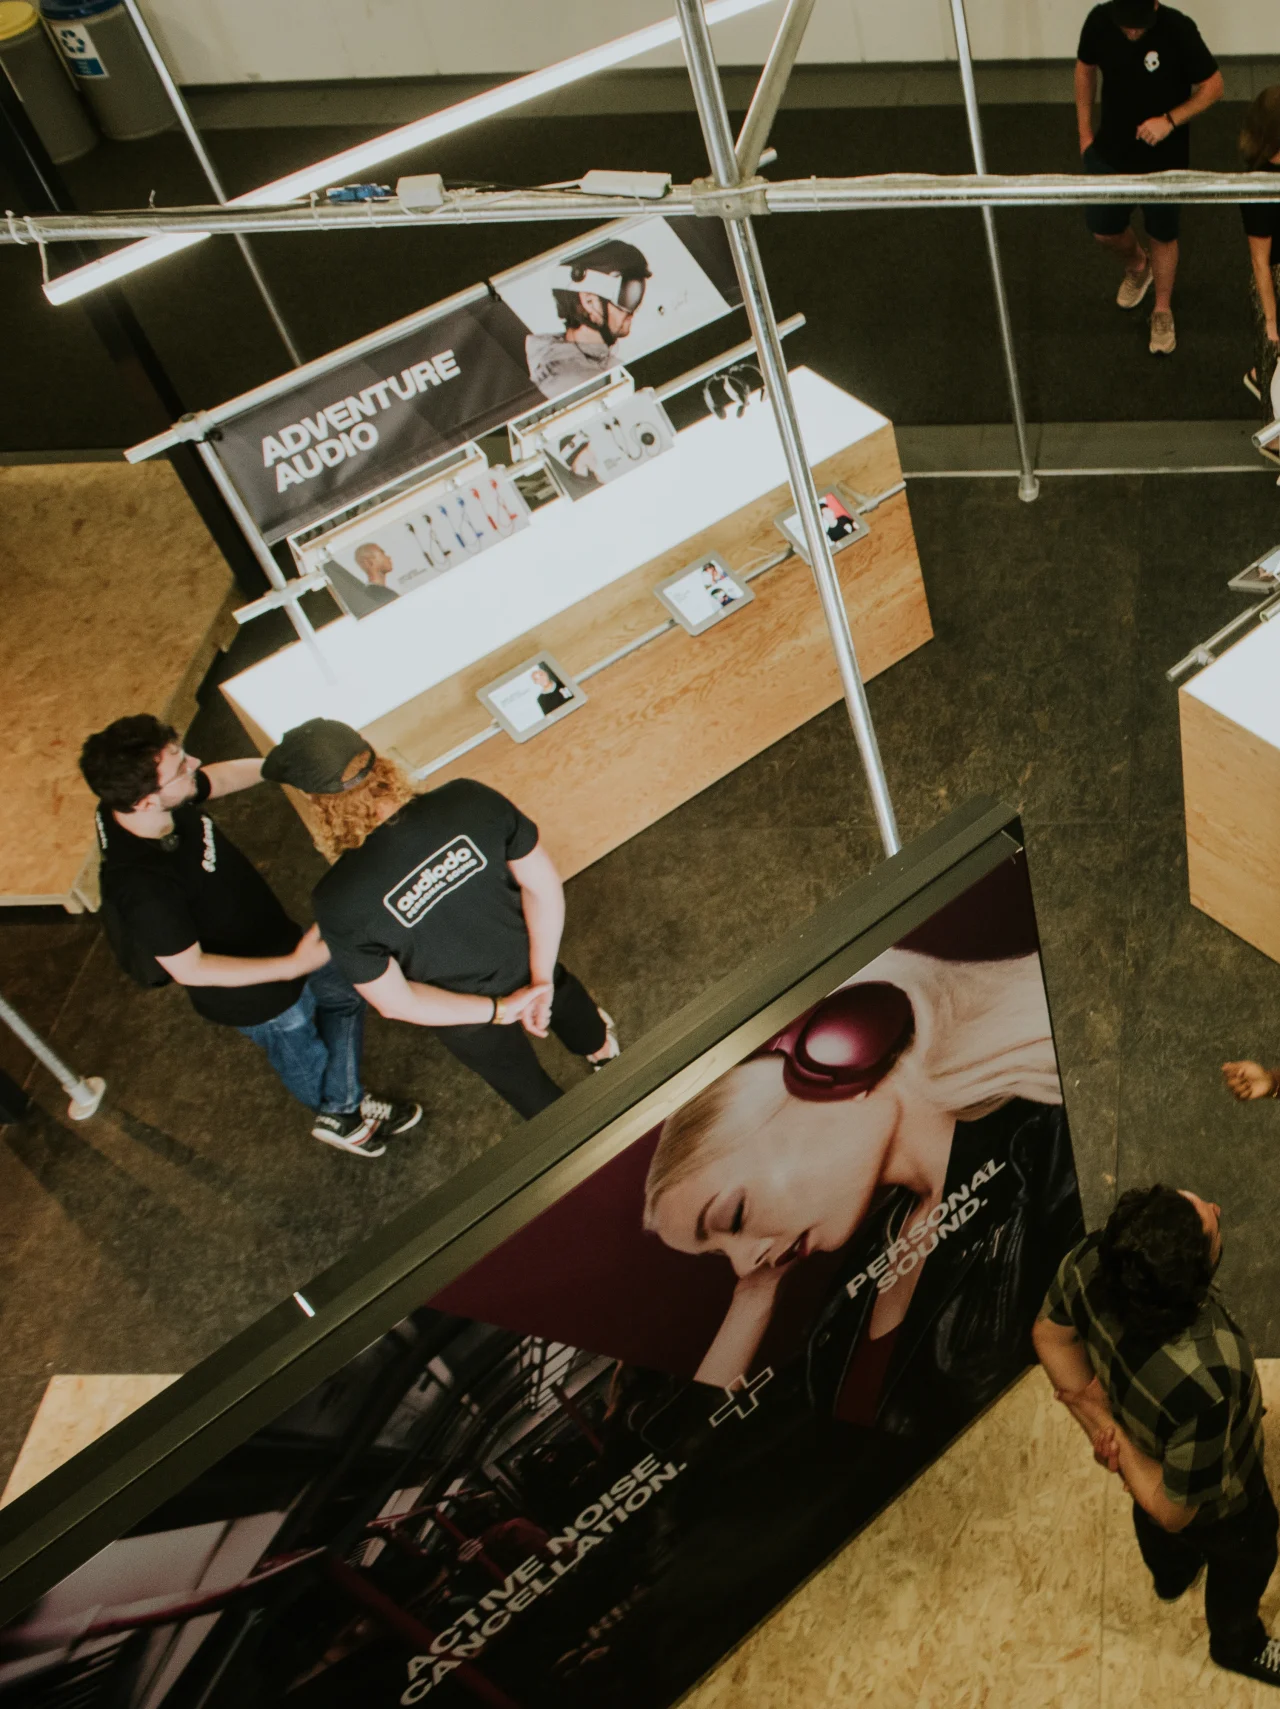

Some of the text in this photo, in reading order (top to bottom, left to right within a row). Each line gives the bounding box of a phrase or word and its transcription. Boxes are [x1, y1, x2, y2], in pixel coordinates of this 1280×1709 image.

[262, 349, 462, 467] ADVENTURE
[275, 422, 380, 493] AUDIO
[397, 847, 472, 912] audiodo
[845, 1158, 1007, 1299] PERSONAL
[876, 1197, 989, 1294] SOUND.
[400, 1460, 688, 1707] CANCELLATION.
[407, 1453, 661, 1681] ACTIVE NOISE
